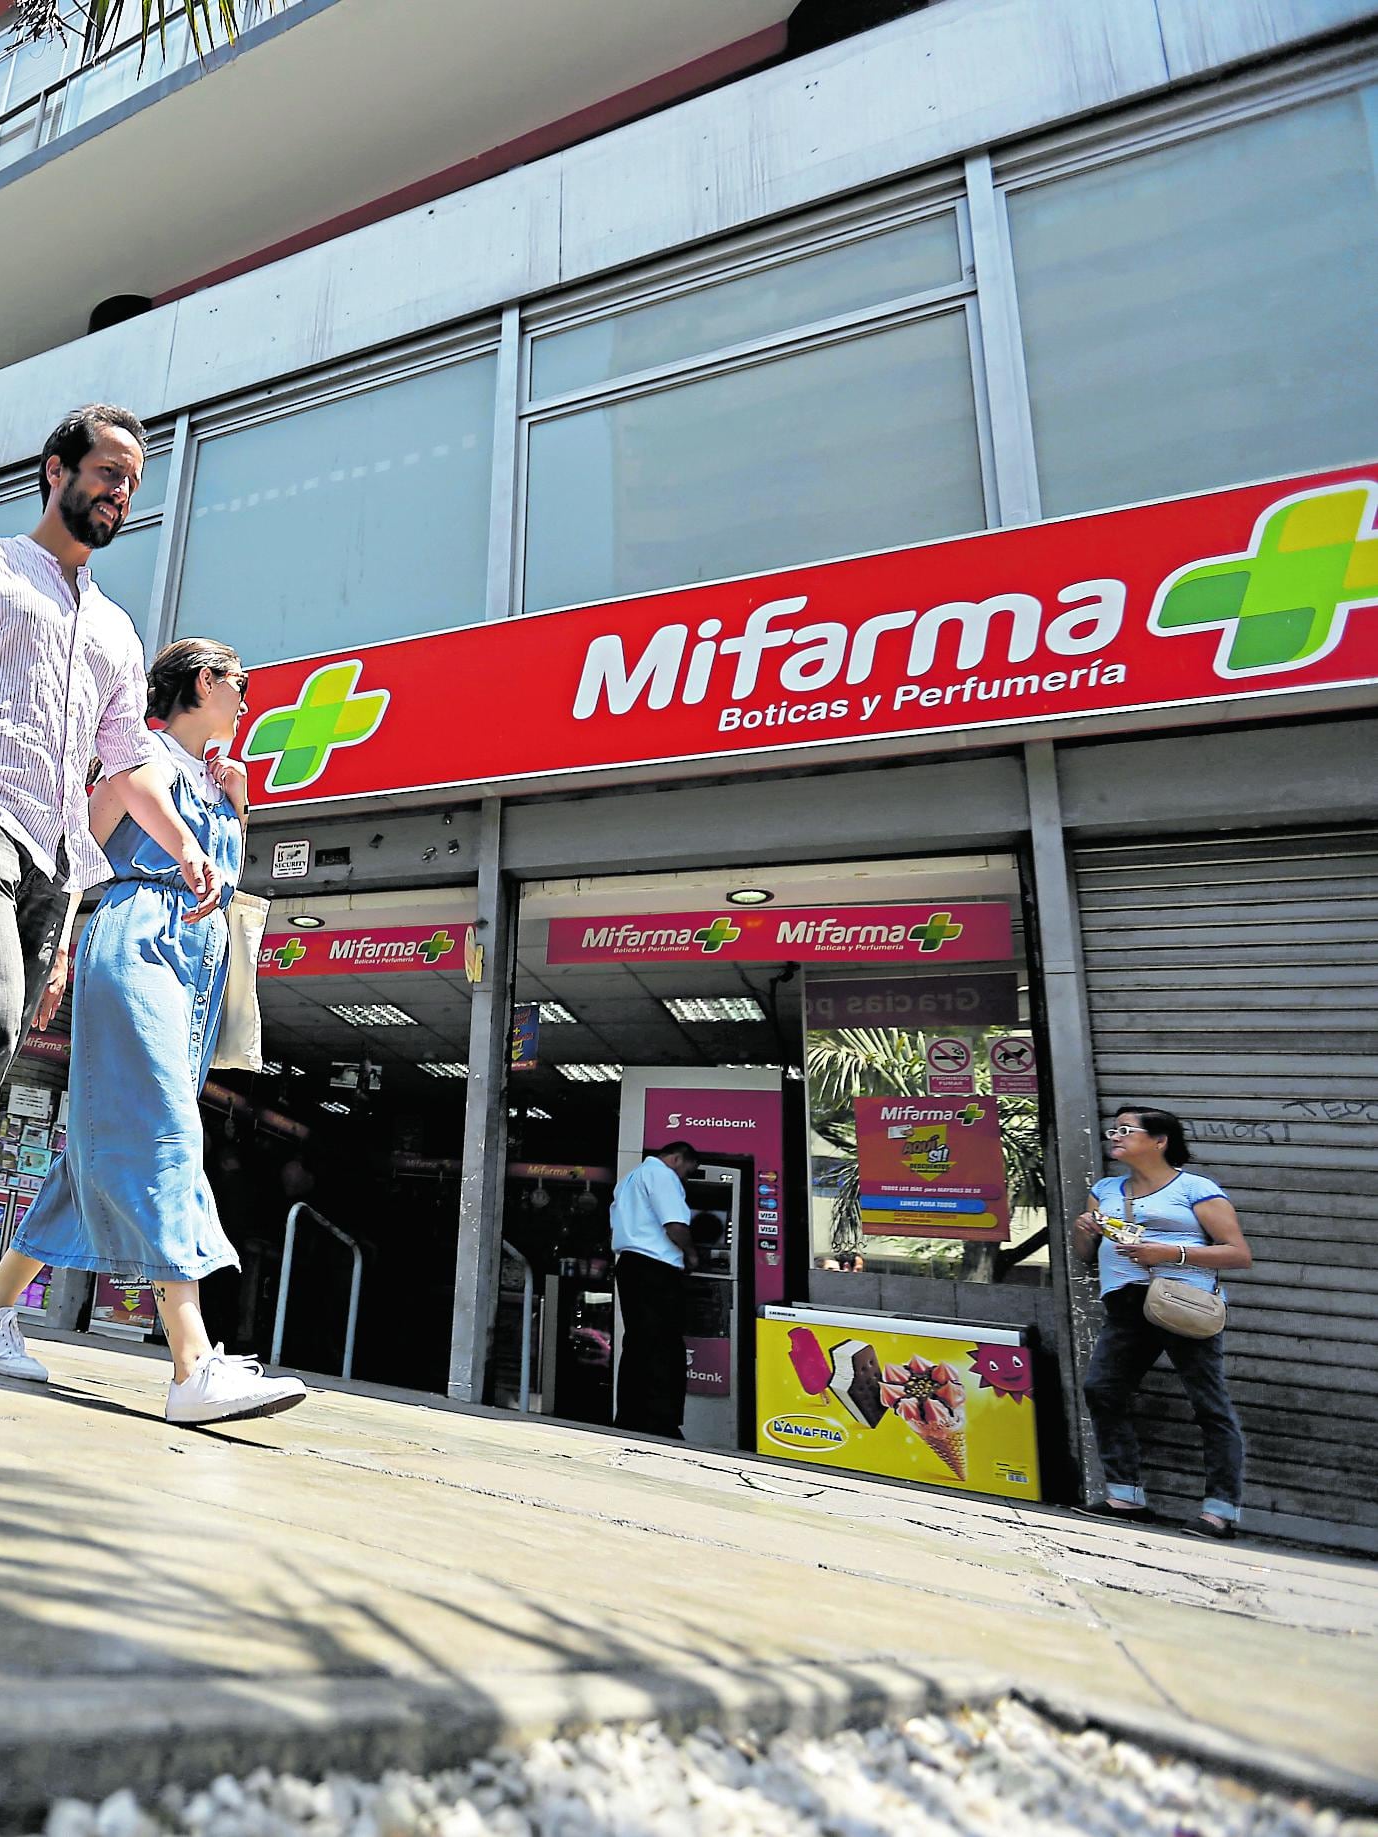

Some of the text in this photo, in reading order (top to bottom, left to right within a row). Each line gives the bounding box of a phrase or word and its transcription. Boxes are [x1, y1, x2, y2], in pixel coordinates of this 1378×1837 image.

[572, 578, 1127, 719] Mifarma
[718, 658, 1127, 732] Boticas y Perfumería
[275, 861, 306, 869] SECURITY
[582, 924, 691, 948] Mifarma
[776, 919, 906, 944] Mifarma
[329, 936, 417, 960] Mifarma
[685, 1117, 757, 1128] Scotiabank
[880, 1105, 953, 1121] Mifarma
[527, 1164, 567, 1177] Mifarma
